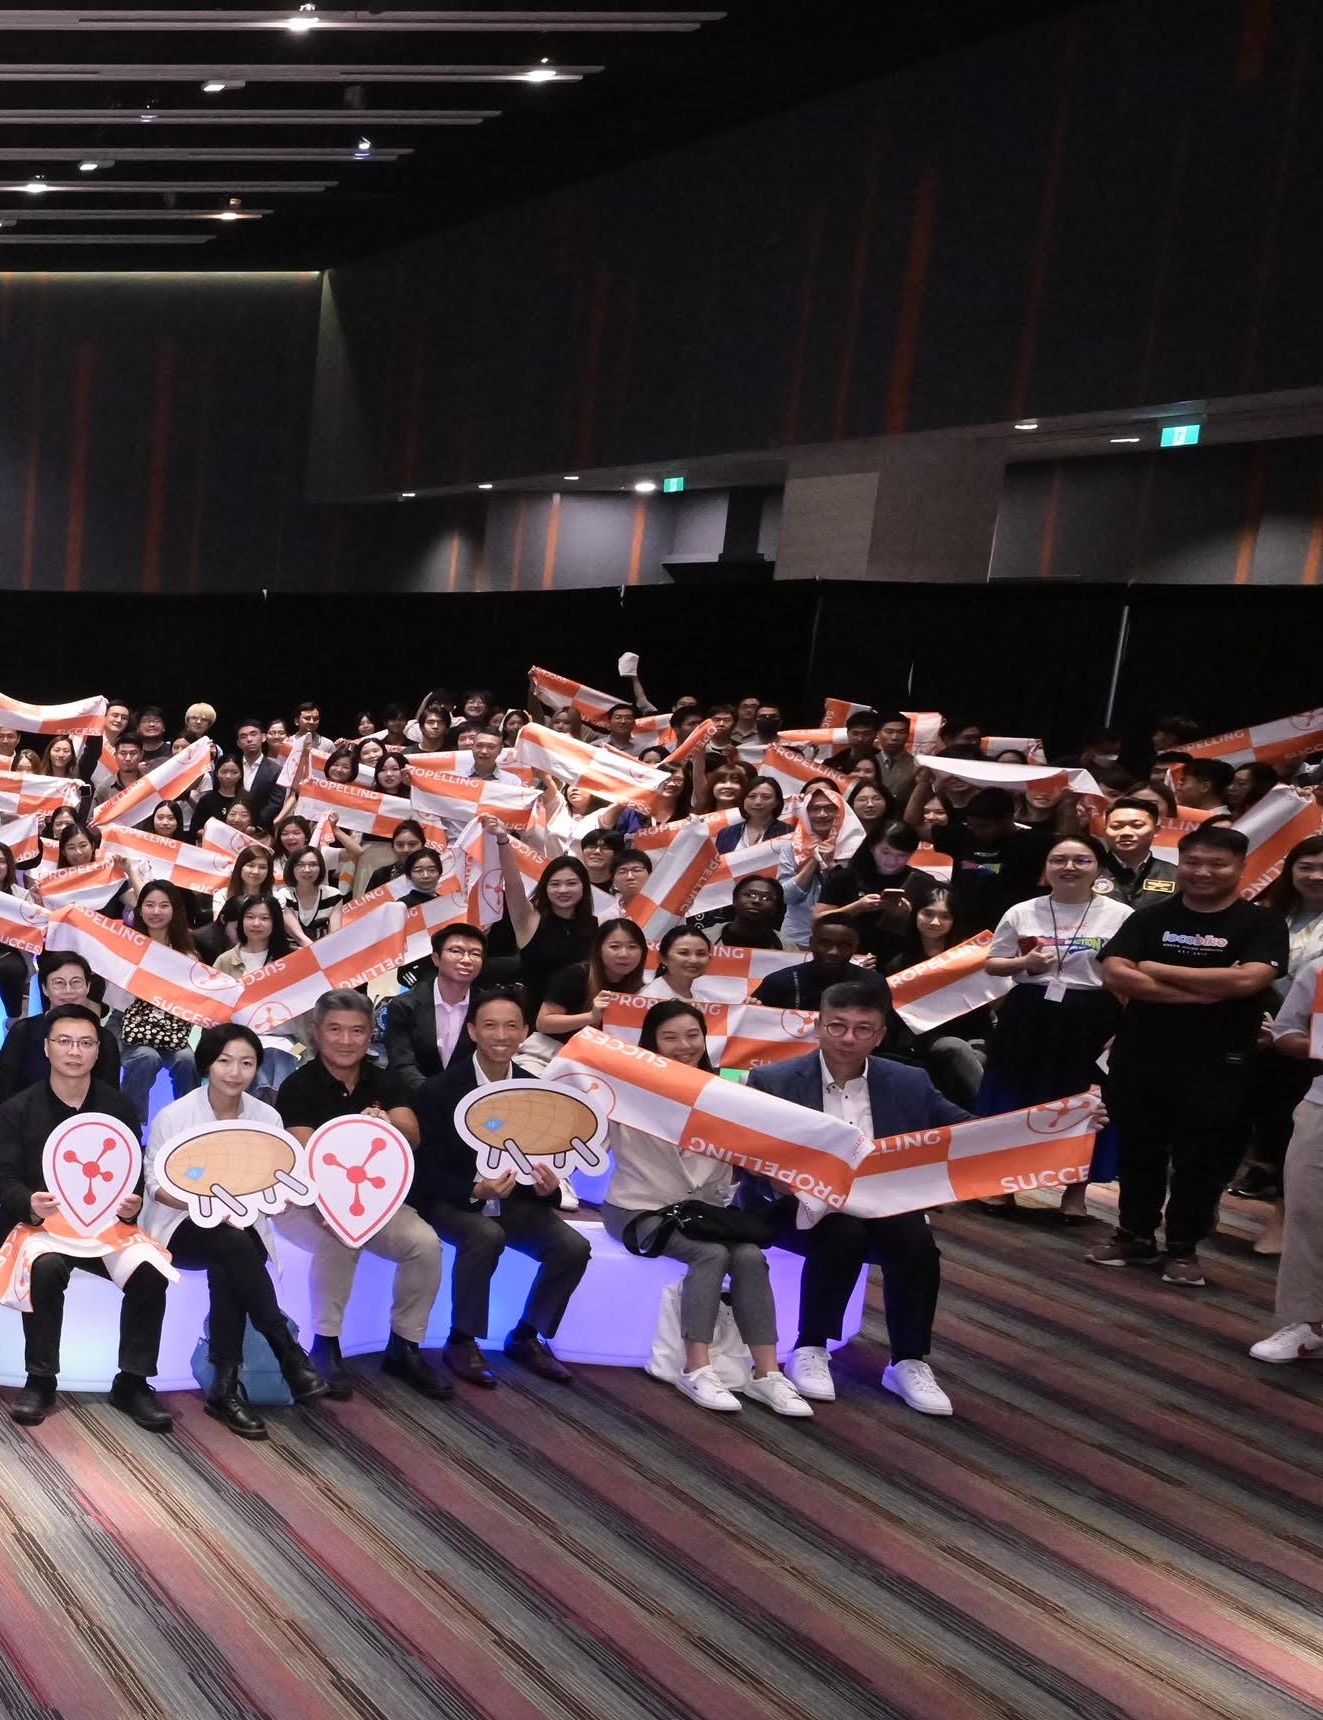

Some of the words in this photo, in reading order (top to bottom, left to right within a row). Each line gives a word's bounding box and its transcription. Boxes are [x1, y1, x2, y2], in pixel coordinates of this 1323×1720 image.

[56, 728, 102, 737] SUCCESS
[152, 996, 223, 1029] SUCCESS
[689, 1136, 847, 1208] PROPELLING
